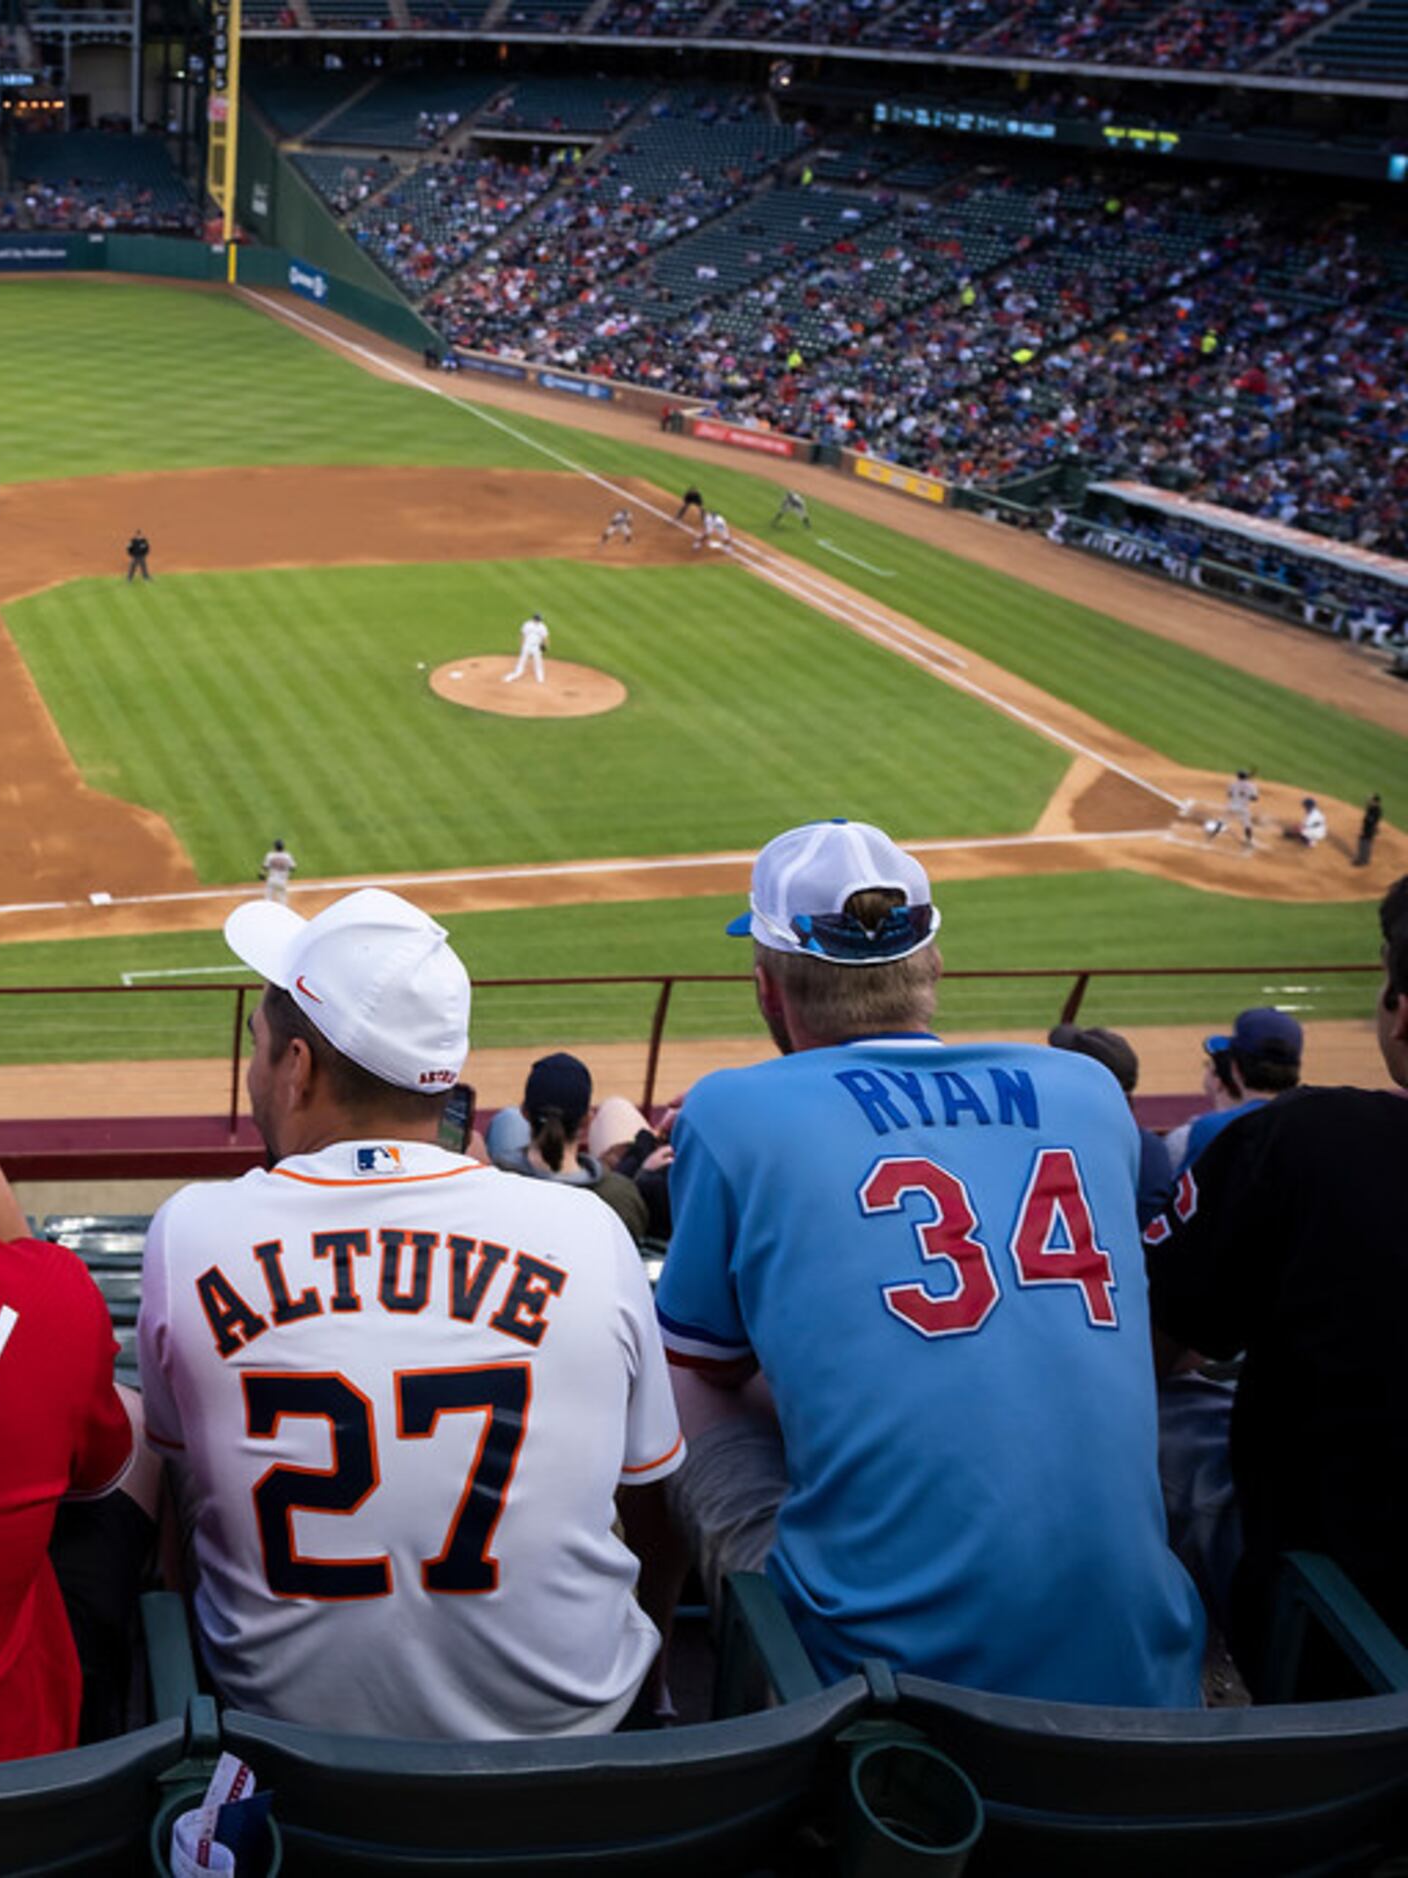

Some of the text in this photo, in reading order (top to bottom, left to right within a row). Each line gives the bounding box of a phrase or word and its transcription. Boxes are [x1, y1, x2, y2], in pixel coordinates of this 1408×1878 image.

[834, 1068, 1040, 1136] RYAN
[195, 1227, 569, 1359] ALTUVE
[856, 1146, 1120, 1340] 34
[240, 1361, 532, 1601] 27
